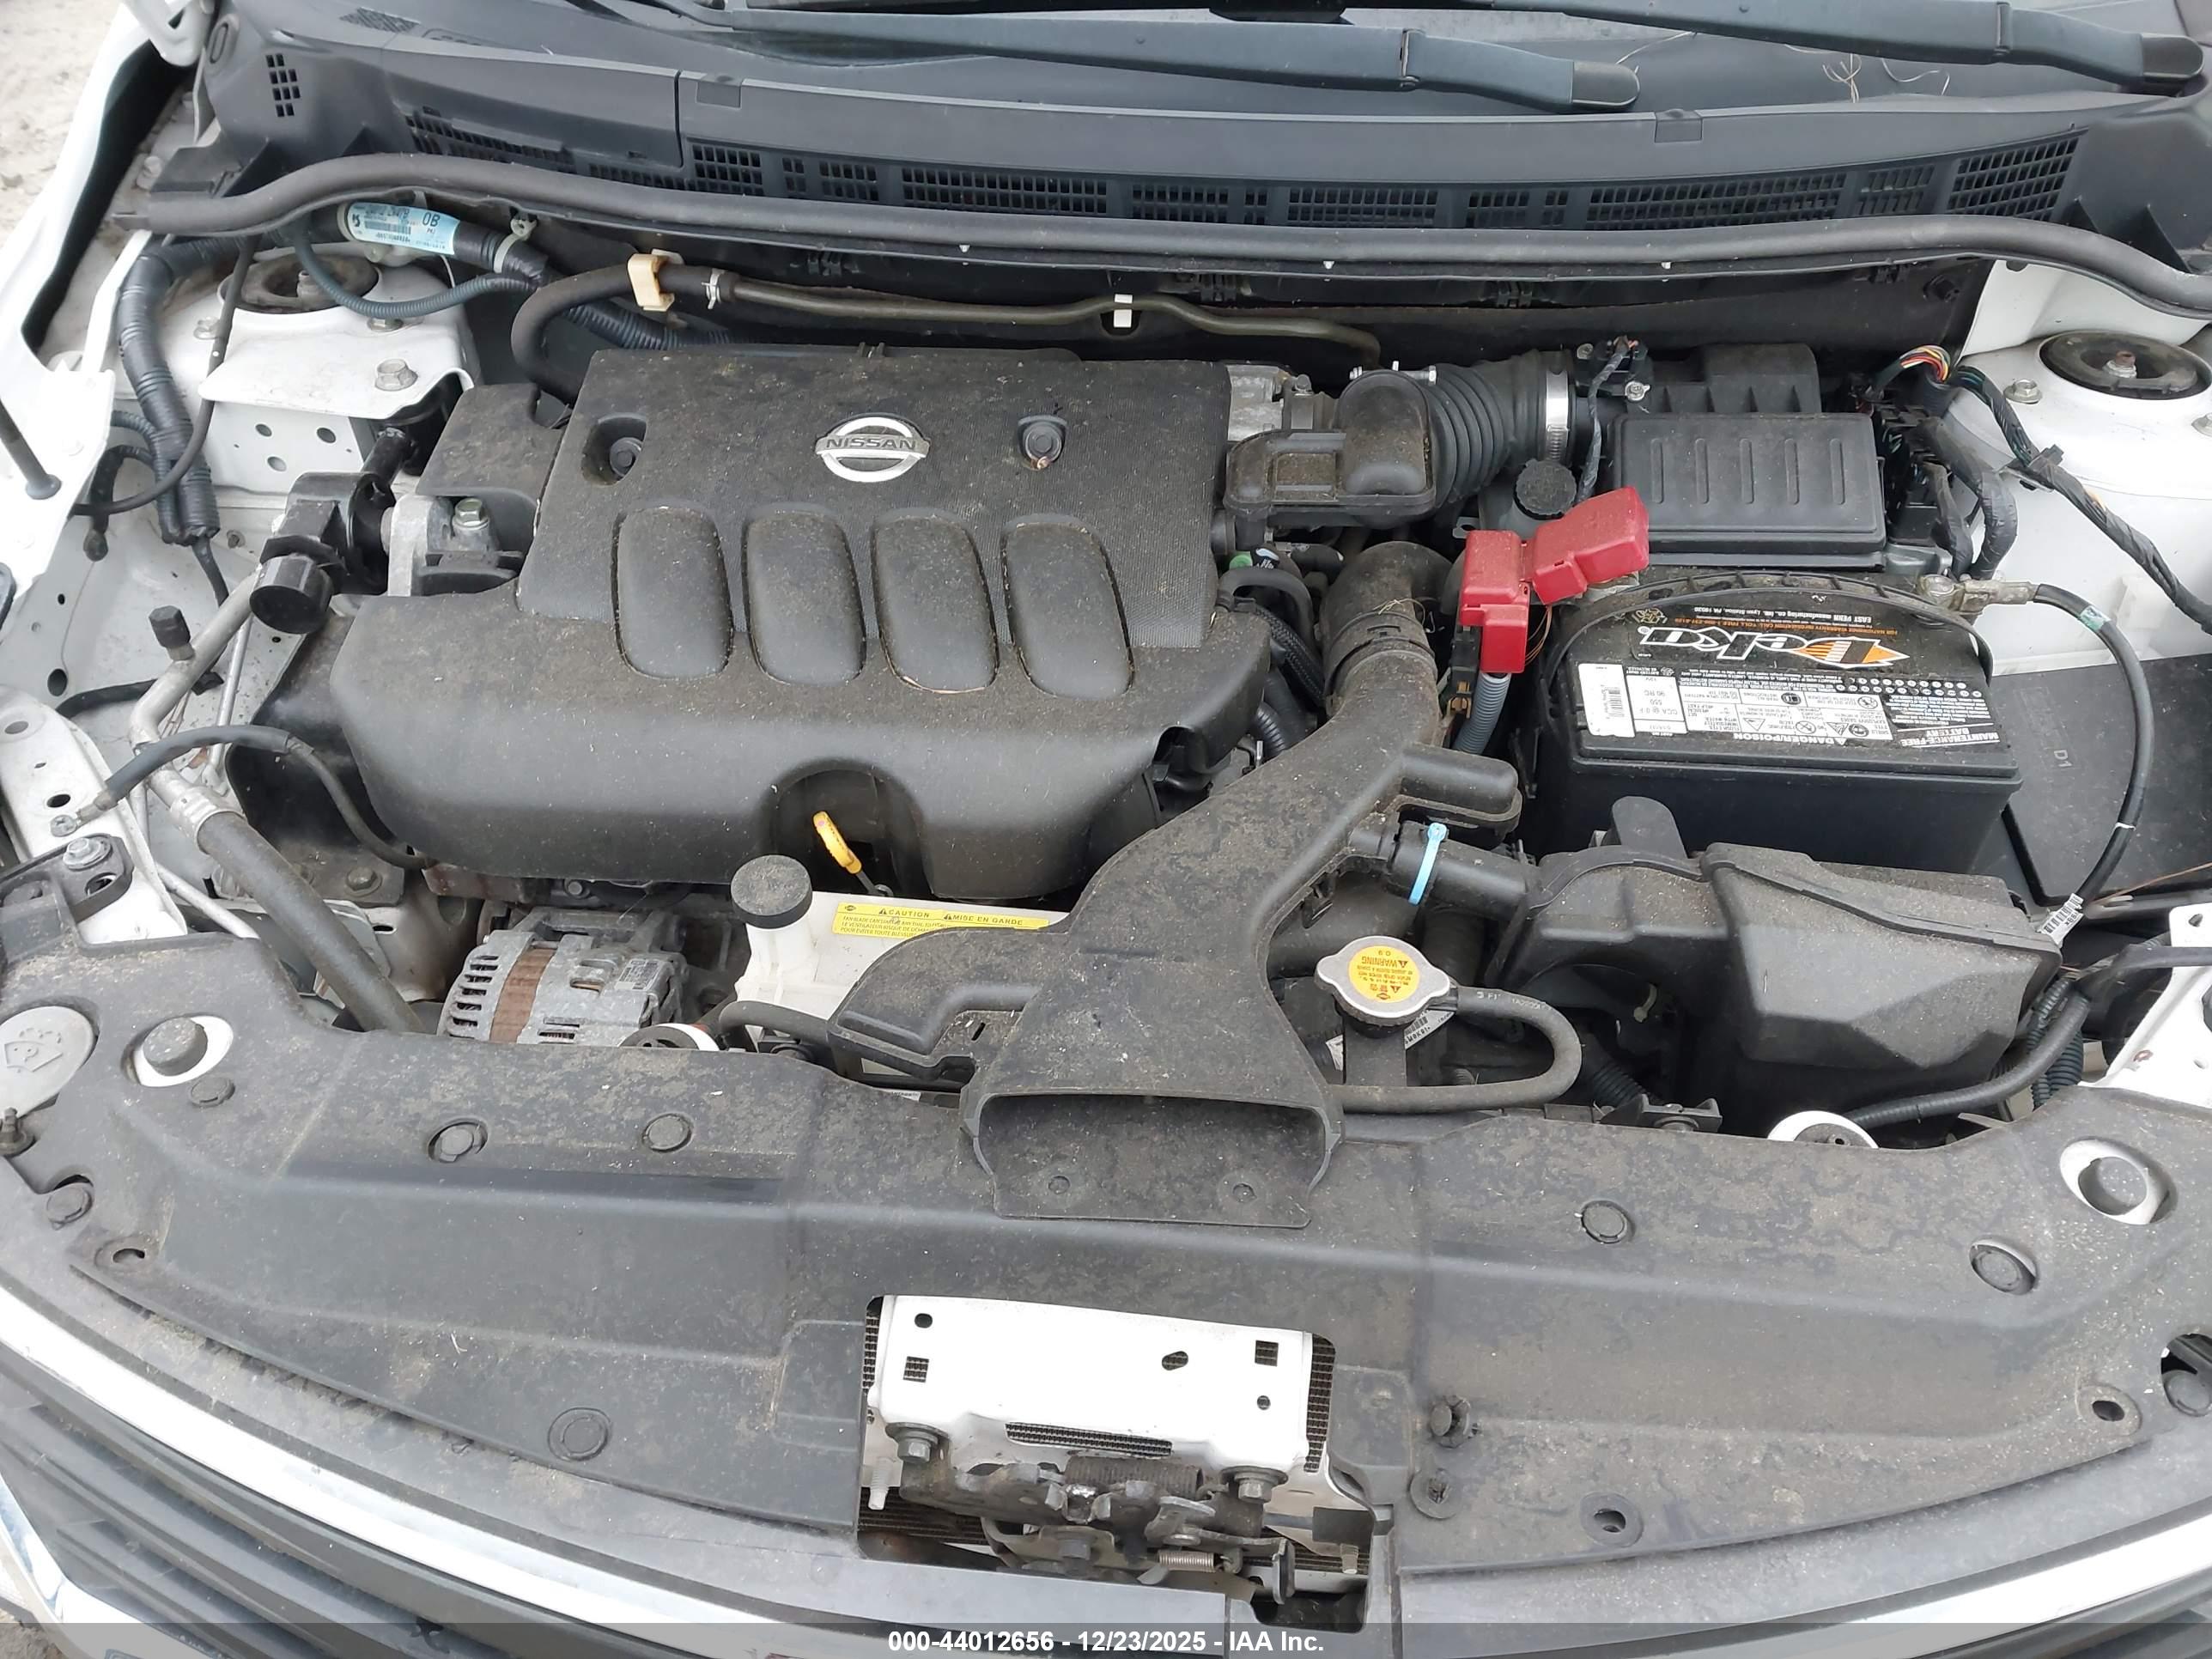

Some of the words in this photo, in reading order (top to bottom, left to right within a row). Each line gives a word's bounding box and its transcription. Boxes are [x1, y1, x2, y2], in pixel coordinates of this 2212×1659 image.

[826, 437, 916, 450] NISSAN
[1788, 611, 1831, 620] manufacturing
[1925, 728, 1970, 737] BATTERY
[1733, 732, 1834, 744] DANGER/POISON
[1899, 732, 1999, 746] MAINTENANCE-FREE
[889, 908, 930, 917] CAUTION
[992, 917, 1024, 926] GARDE
[1361, 956, 1397, 967] WARNING
